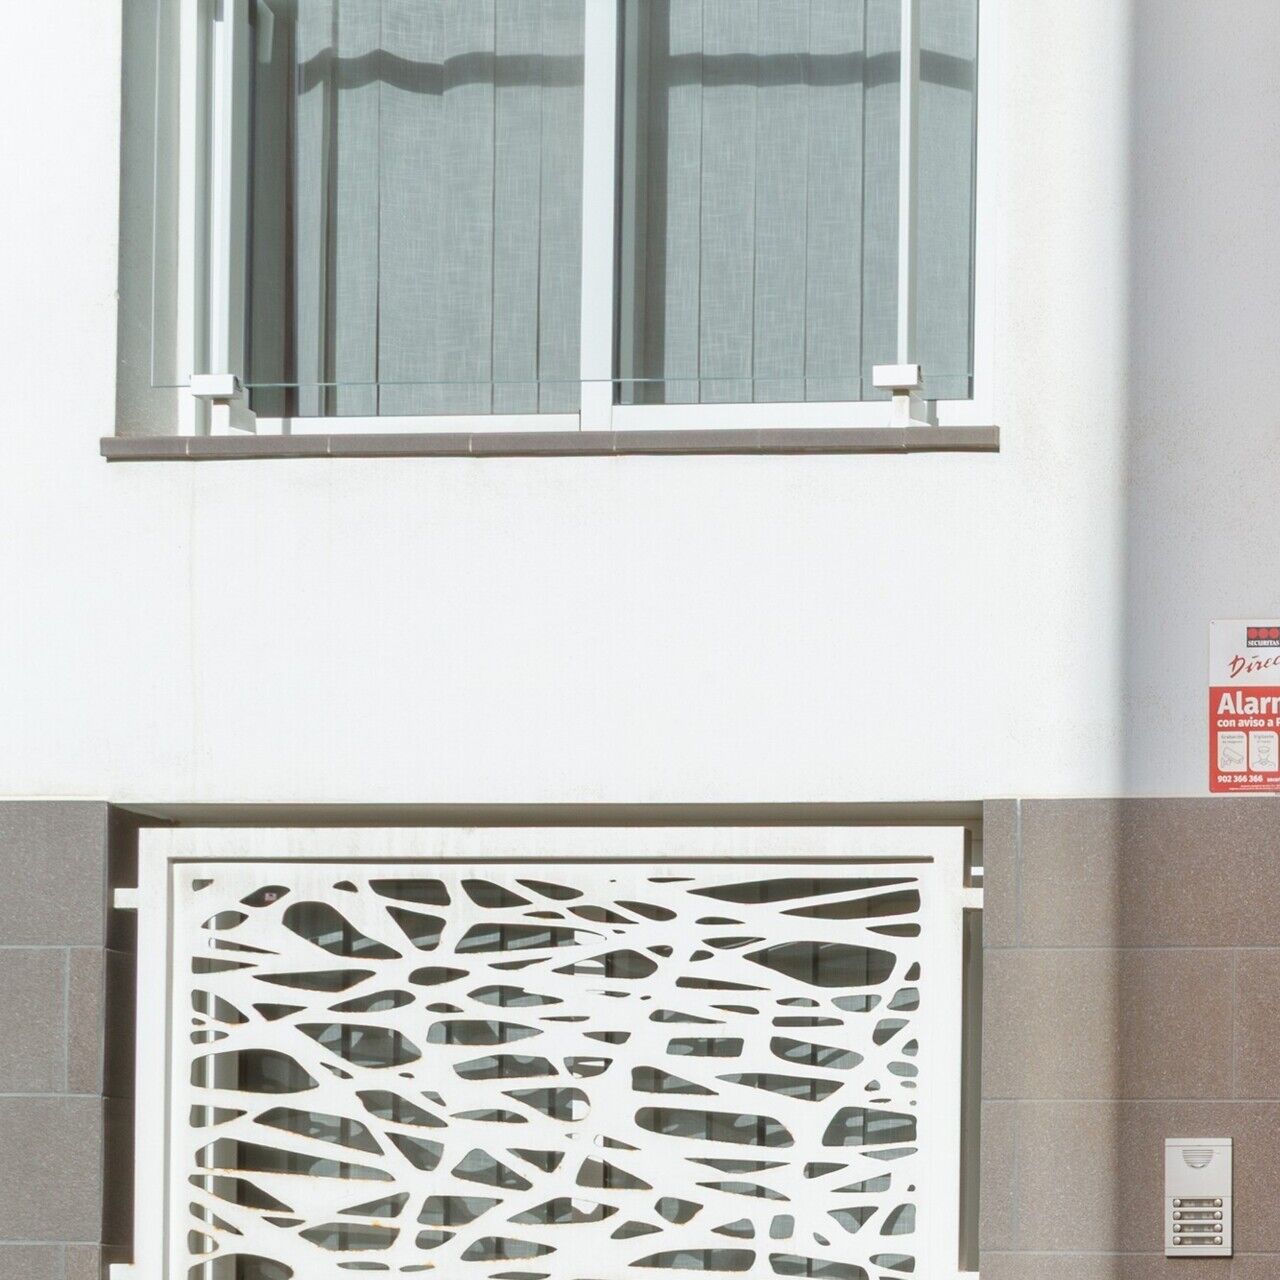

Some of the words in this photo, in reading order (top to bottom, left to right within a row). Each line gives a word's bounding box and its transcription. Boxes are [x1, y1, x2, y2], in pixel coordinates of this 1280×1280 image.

[1217, 718, 1236, 728] con
[1238, 716, 1265, 728] aviso
[1267, 718, 1274, 728] a
[1217, 774, 1232, 783] 902
[1233, 774, 1248, 783] 366
